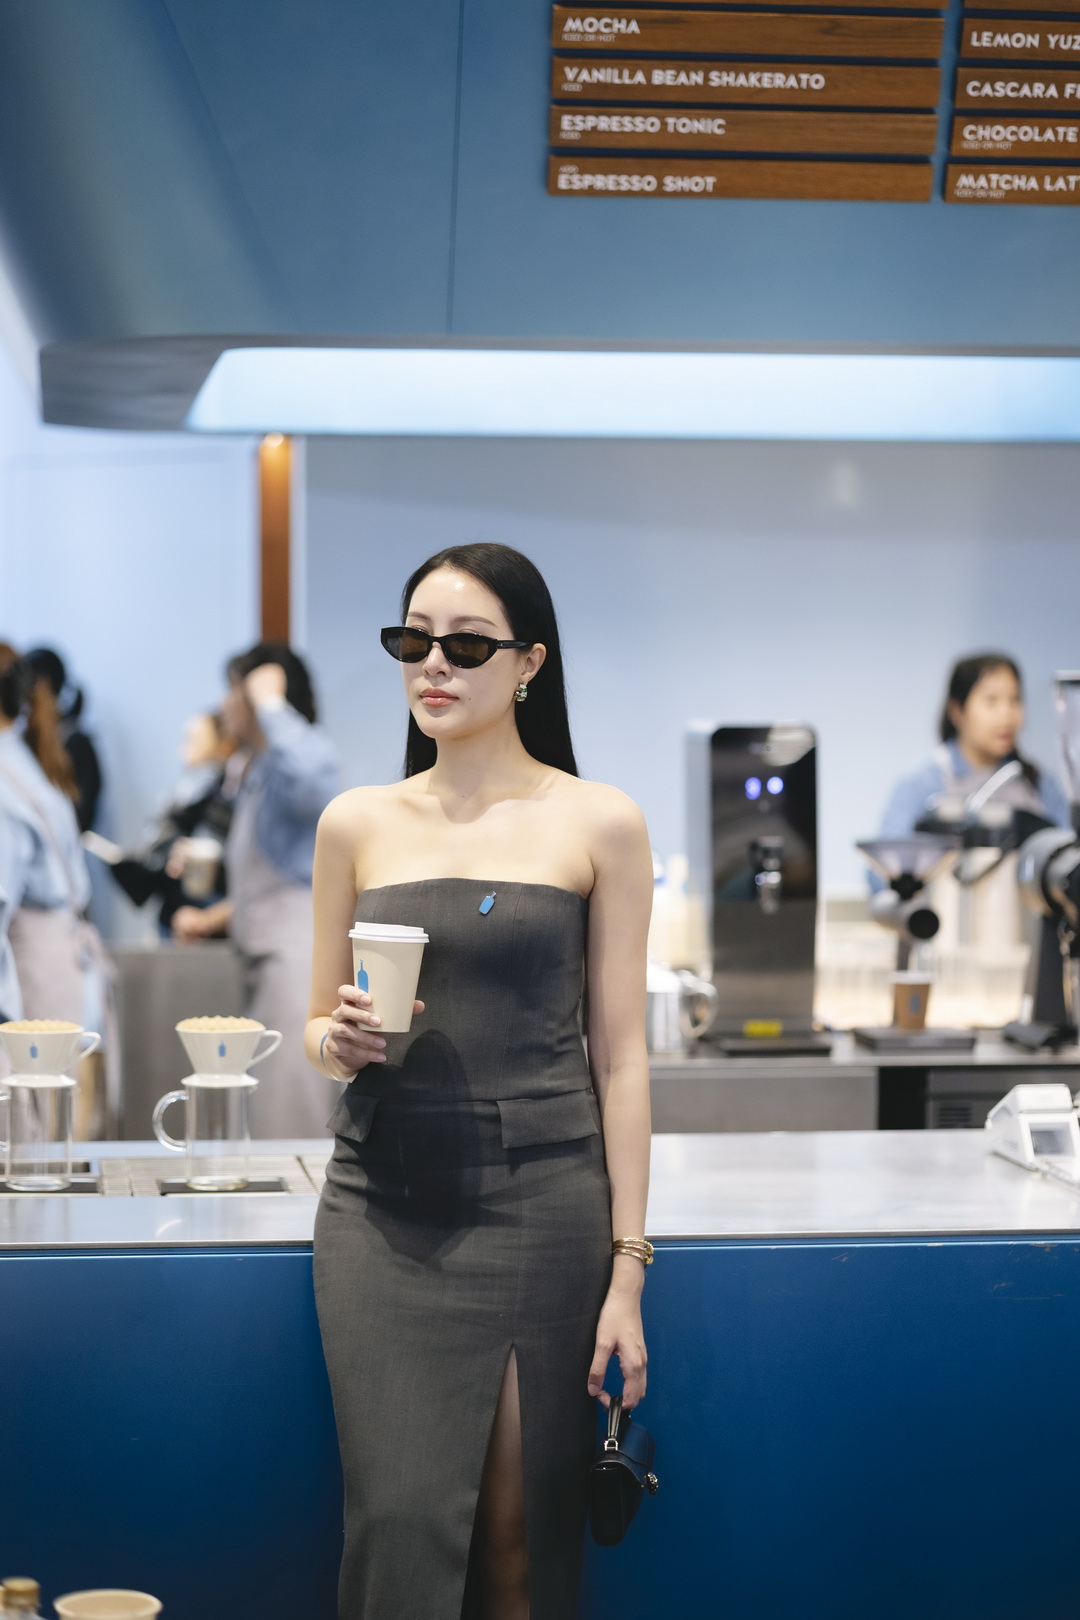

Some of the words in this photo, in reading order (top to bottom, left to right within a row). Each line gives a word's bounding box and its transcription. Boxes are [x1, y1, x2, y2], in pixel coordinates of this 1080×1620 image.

[563, 16, 641, 35] MOCHA
[970, 31, 1040, 49] LEMON
[563, 66, 647, 85] VANILLA
[651, 69, 704, 86] BEAN
[708, 71, 826, 90] SHAKERATO
[966, 80, 1059, 98] CASCARA
[560, 115, 661, 133] ESPRESSO
[665, 117, 726, 135] TONIC
[962, 124, 1079, 143] CHOCOLATE
[557, 174, 658, 192] ESPRESSO
[662, 176, 717, 193] SHOT
[956, 173, 1040, 191] MATCHA
